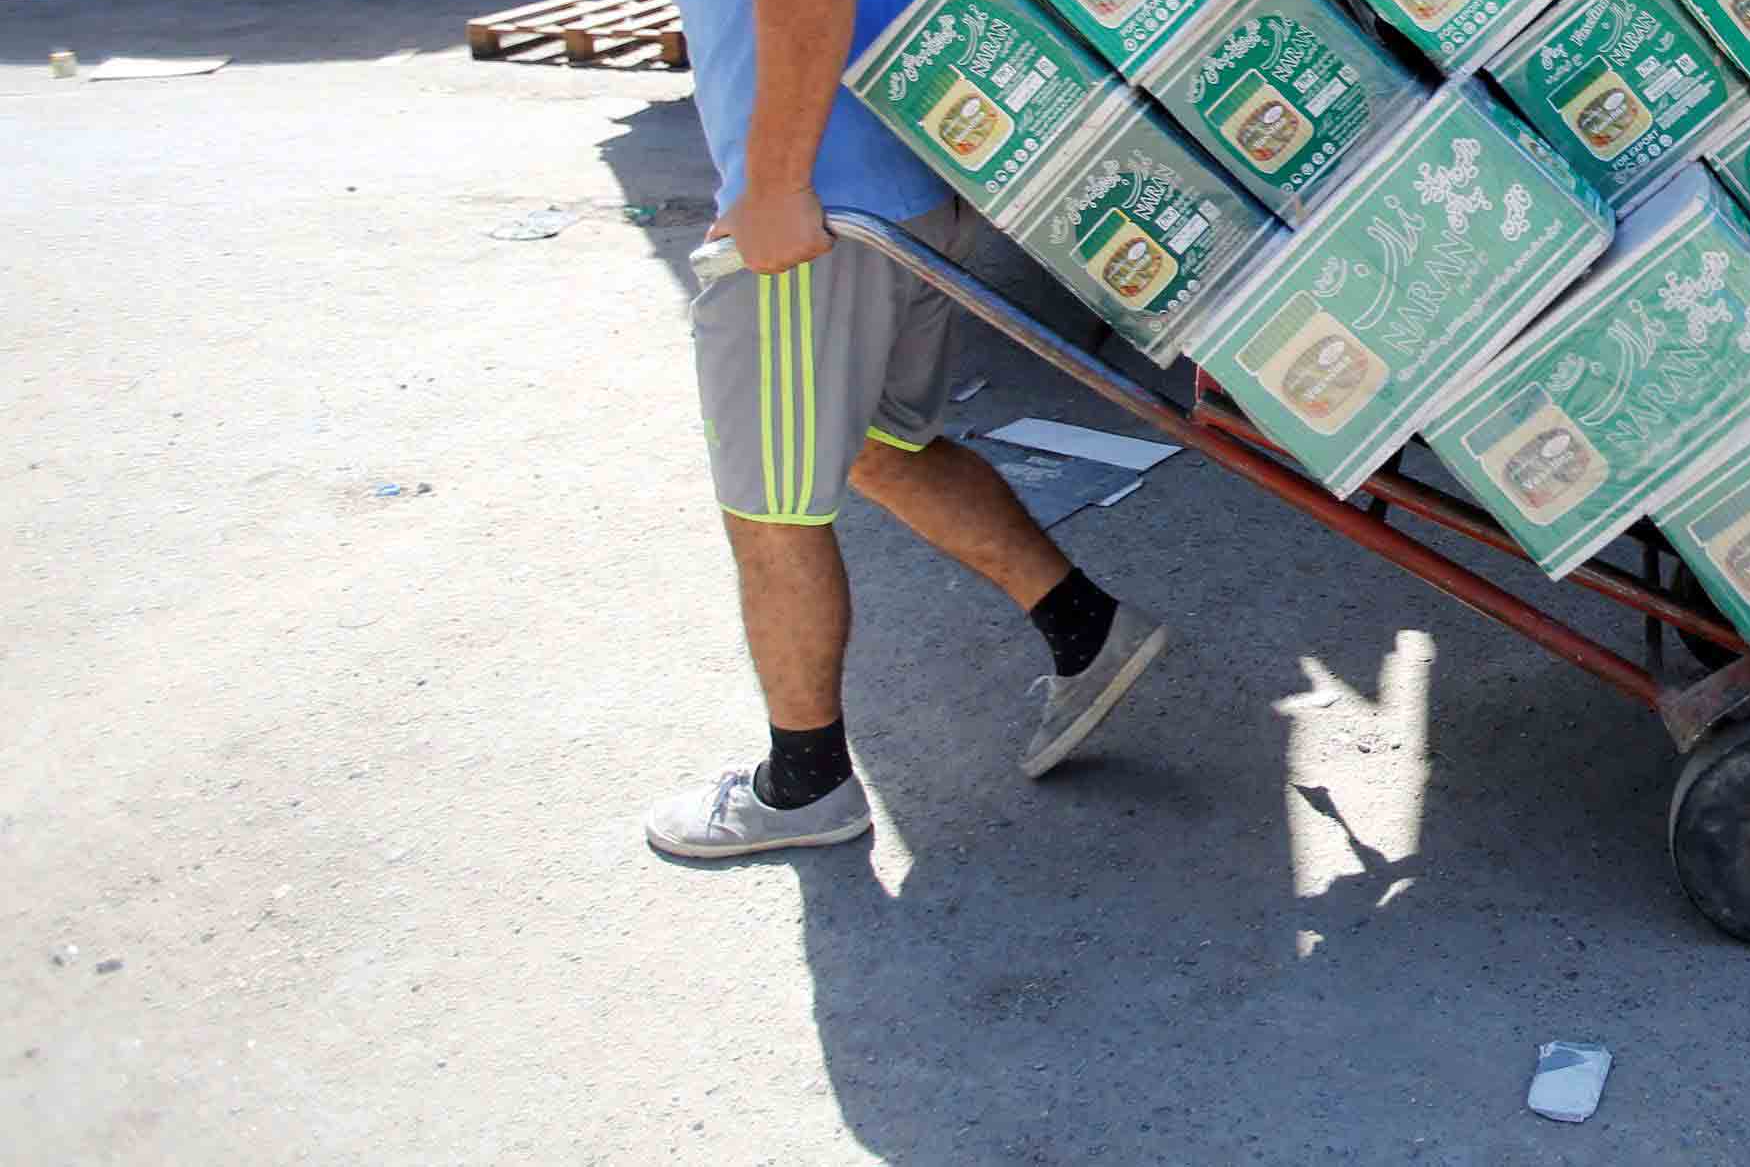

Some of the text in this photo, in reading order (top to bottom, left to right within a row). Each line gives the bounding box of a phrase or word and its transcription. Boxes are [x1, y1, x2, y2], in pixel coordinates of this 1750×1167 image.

[968, 17, 1010, 77] NARAN
[1271, 24, 1316, 82] NARAN
[1609, 9, 1657, 66] NARAN
[1611, 129, 1659, 171] FOR EXPORT
[1132, 164, 1173, 220] NARAN
[1380, 228, 1474, 354] NARAN
[1606, 335, 1710, 453] NARAN
